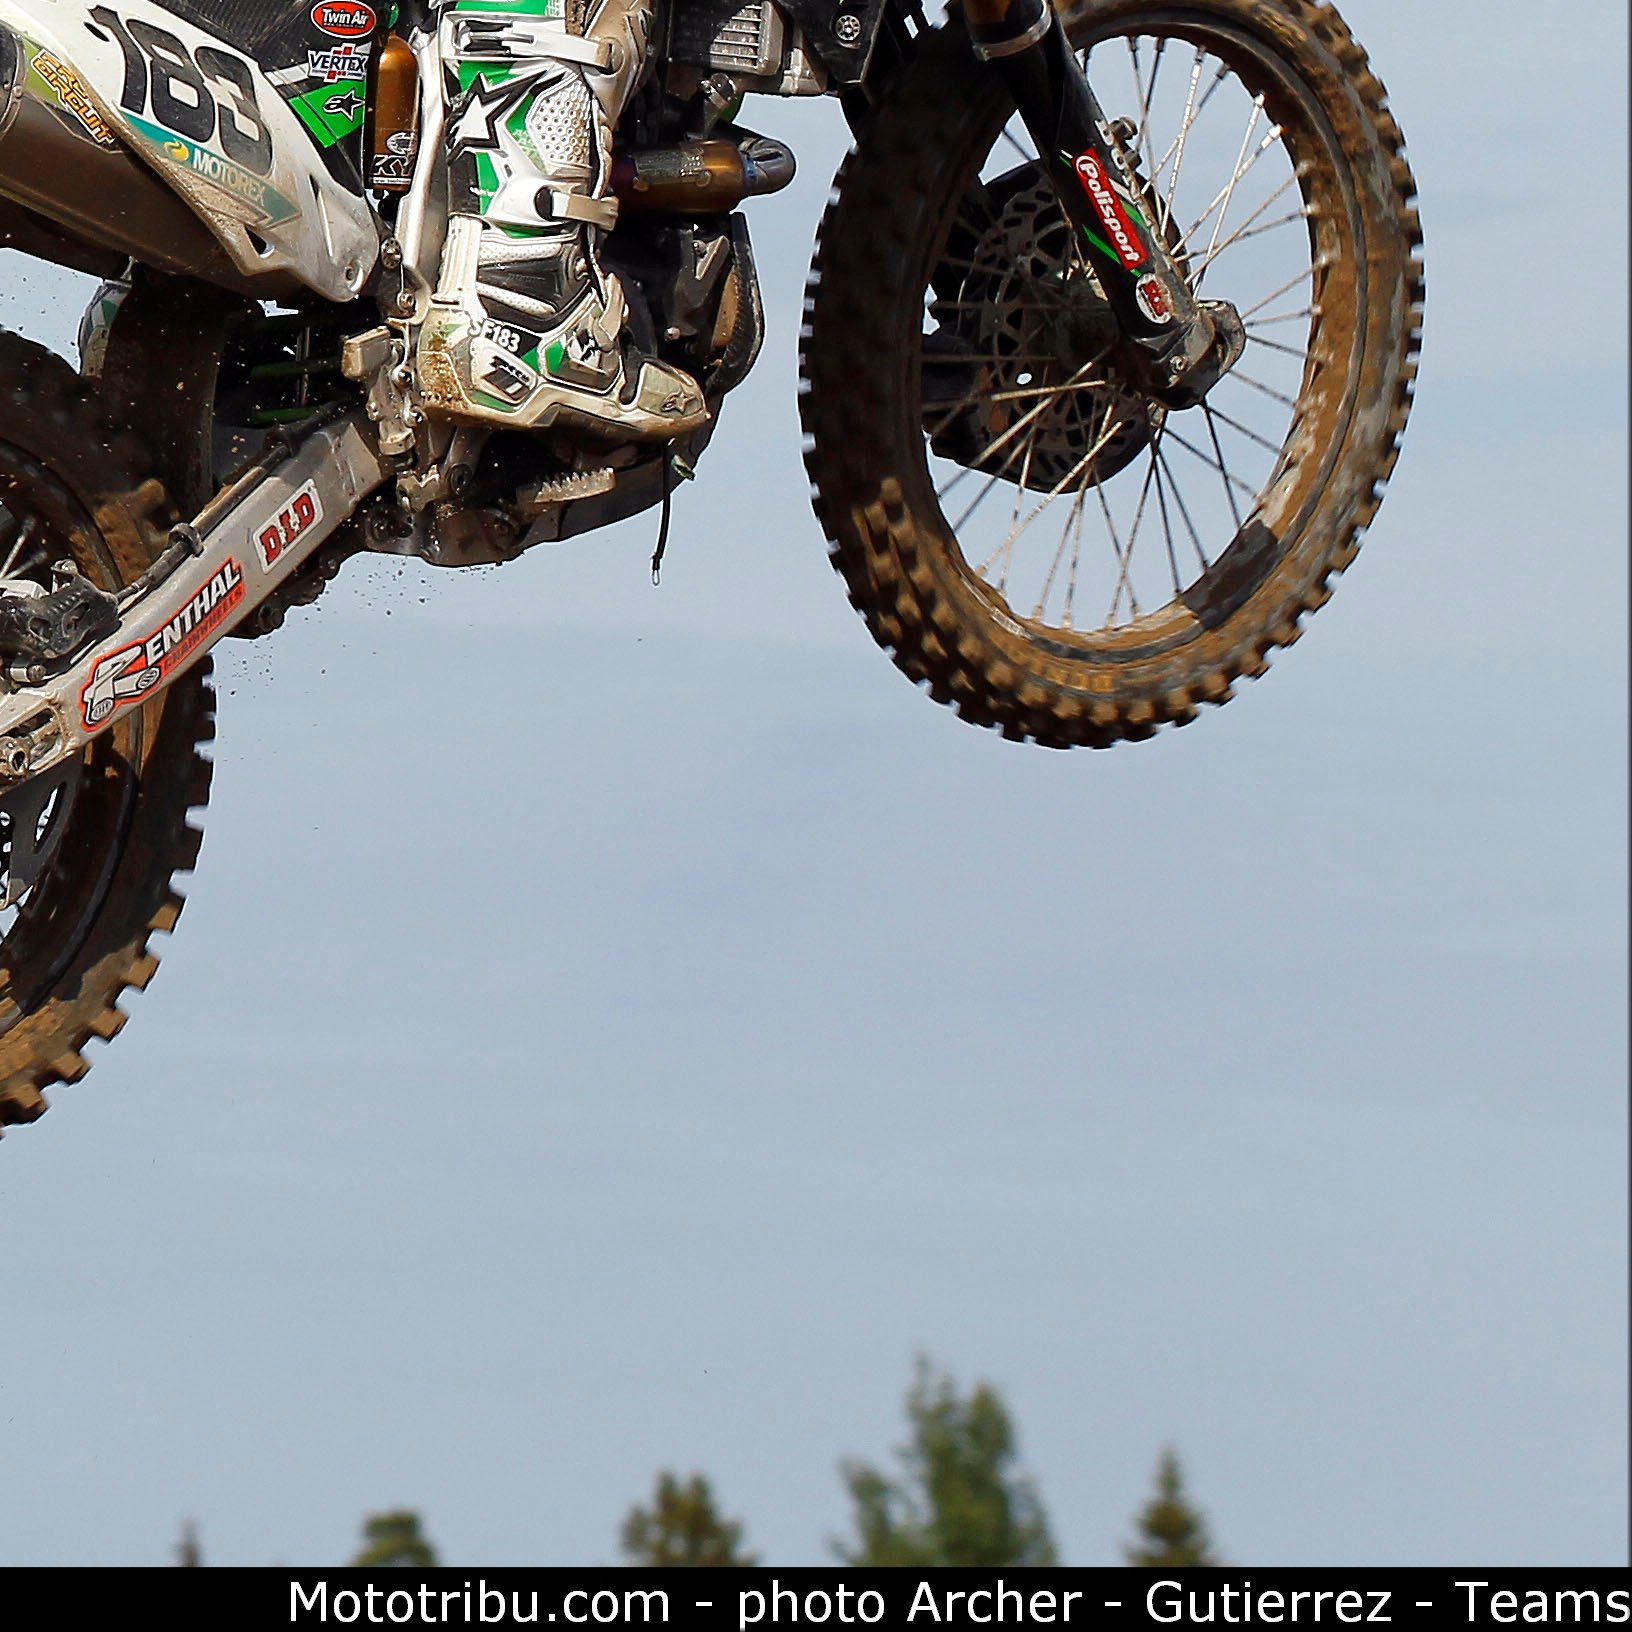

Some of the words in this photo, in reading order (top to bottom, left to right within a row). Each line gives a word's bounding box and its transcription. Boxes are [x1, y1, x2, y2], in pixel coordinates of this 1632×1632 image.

[322, 9, 351, 25] Twin
[351, 10, 370, 25] Air
[88, 5, 273, 176] 183
[310, 52, 368, 72] VERTEX
[1079, 161, 1141, 262] Polisport
